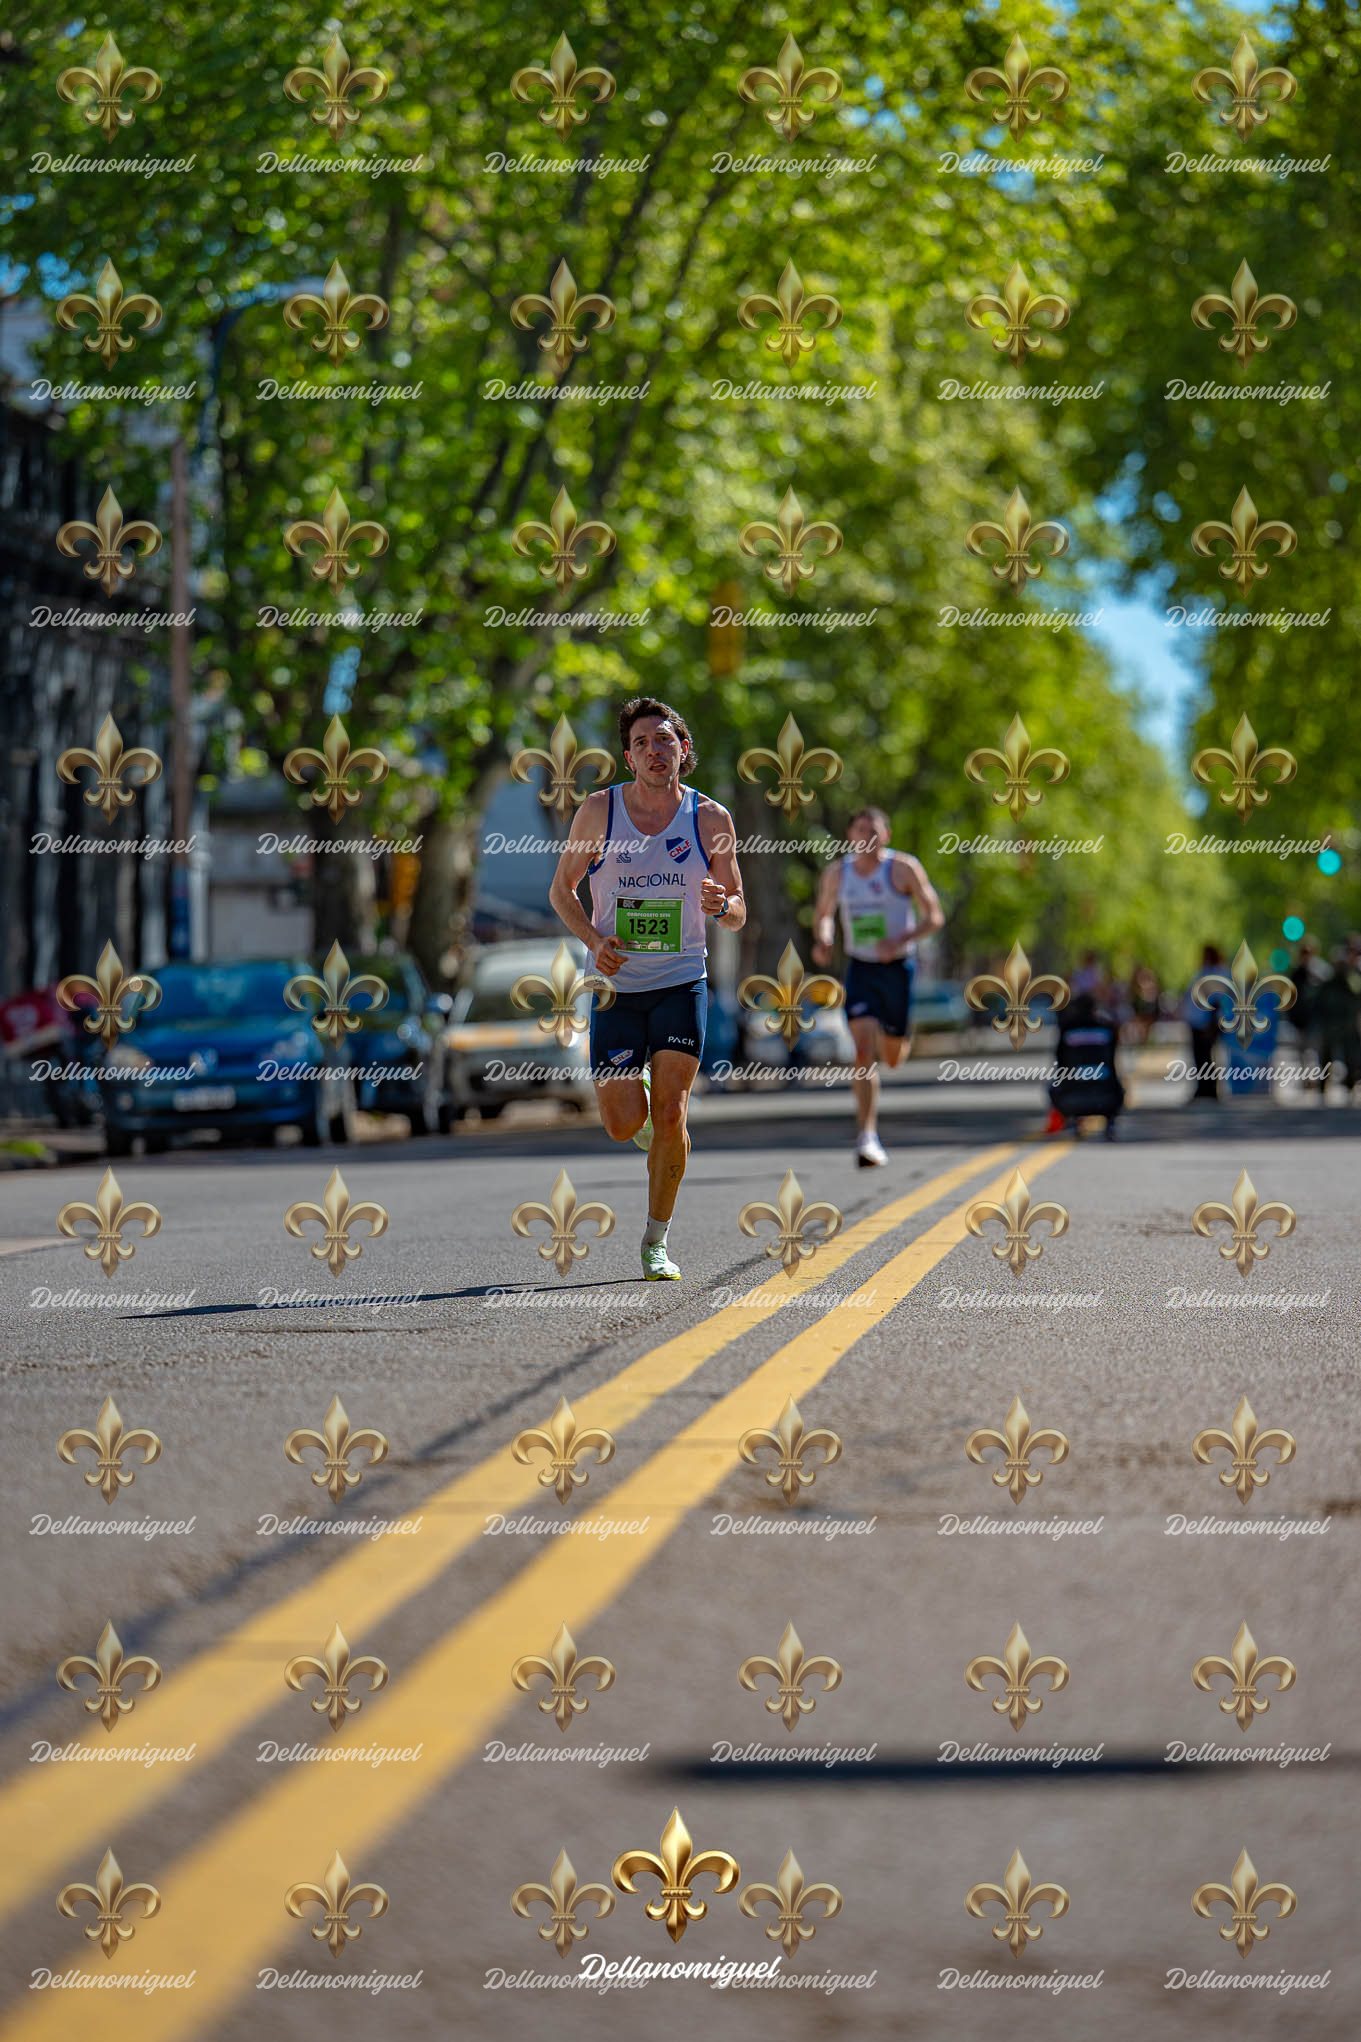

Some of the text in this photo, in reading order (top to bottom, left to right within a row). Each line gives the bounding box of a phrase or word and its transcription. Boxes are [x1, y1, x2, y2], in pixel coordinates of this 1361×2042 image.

[618, 872, 686, 888] NACIONAL
[629, 918, 669, 935] 1523
[667, 1035, 695, 1047] PACK
